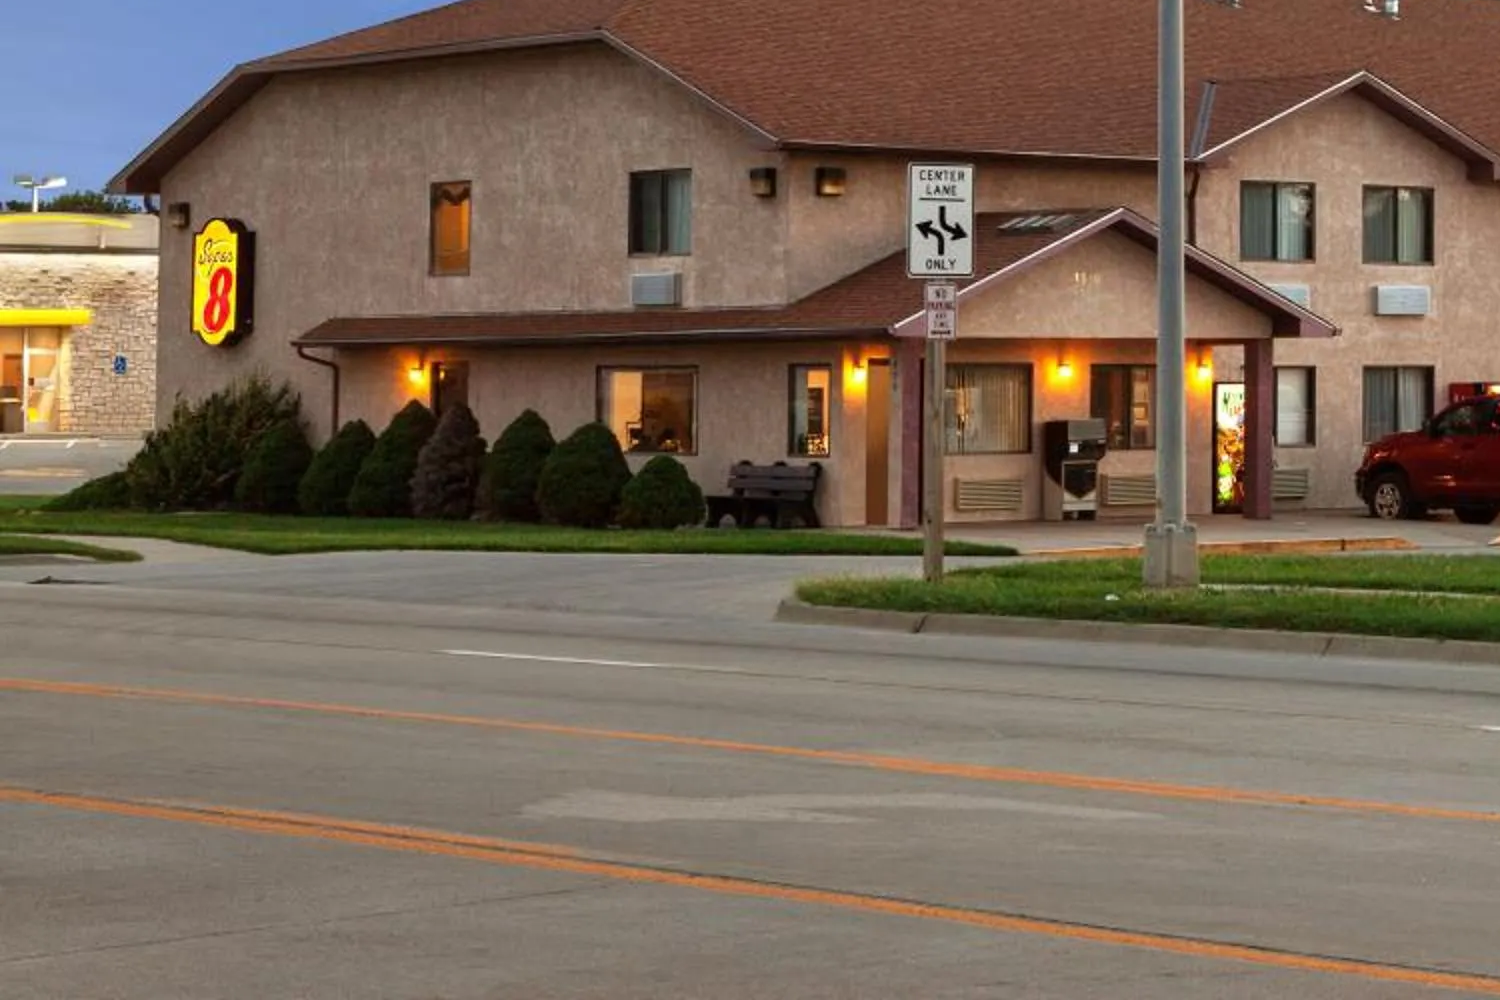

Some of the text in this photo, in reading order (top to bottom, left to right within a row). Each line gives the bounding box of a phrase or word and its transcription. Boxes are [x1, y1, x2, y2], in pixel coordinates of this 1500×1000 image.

[919, 168, 966, 181] CENTER
[924, 184, 958, 196] LANE
[924, 258, 957, 270] ONLY
[203, 266, 233, 333] 8
